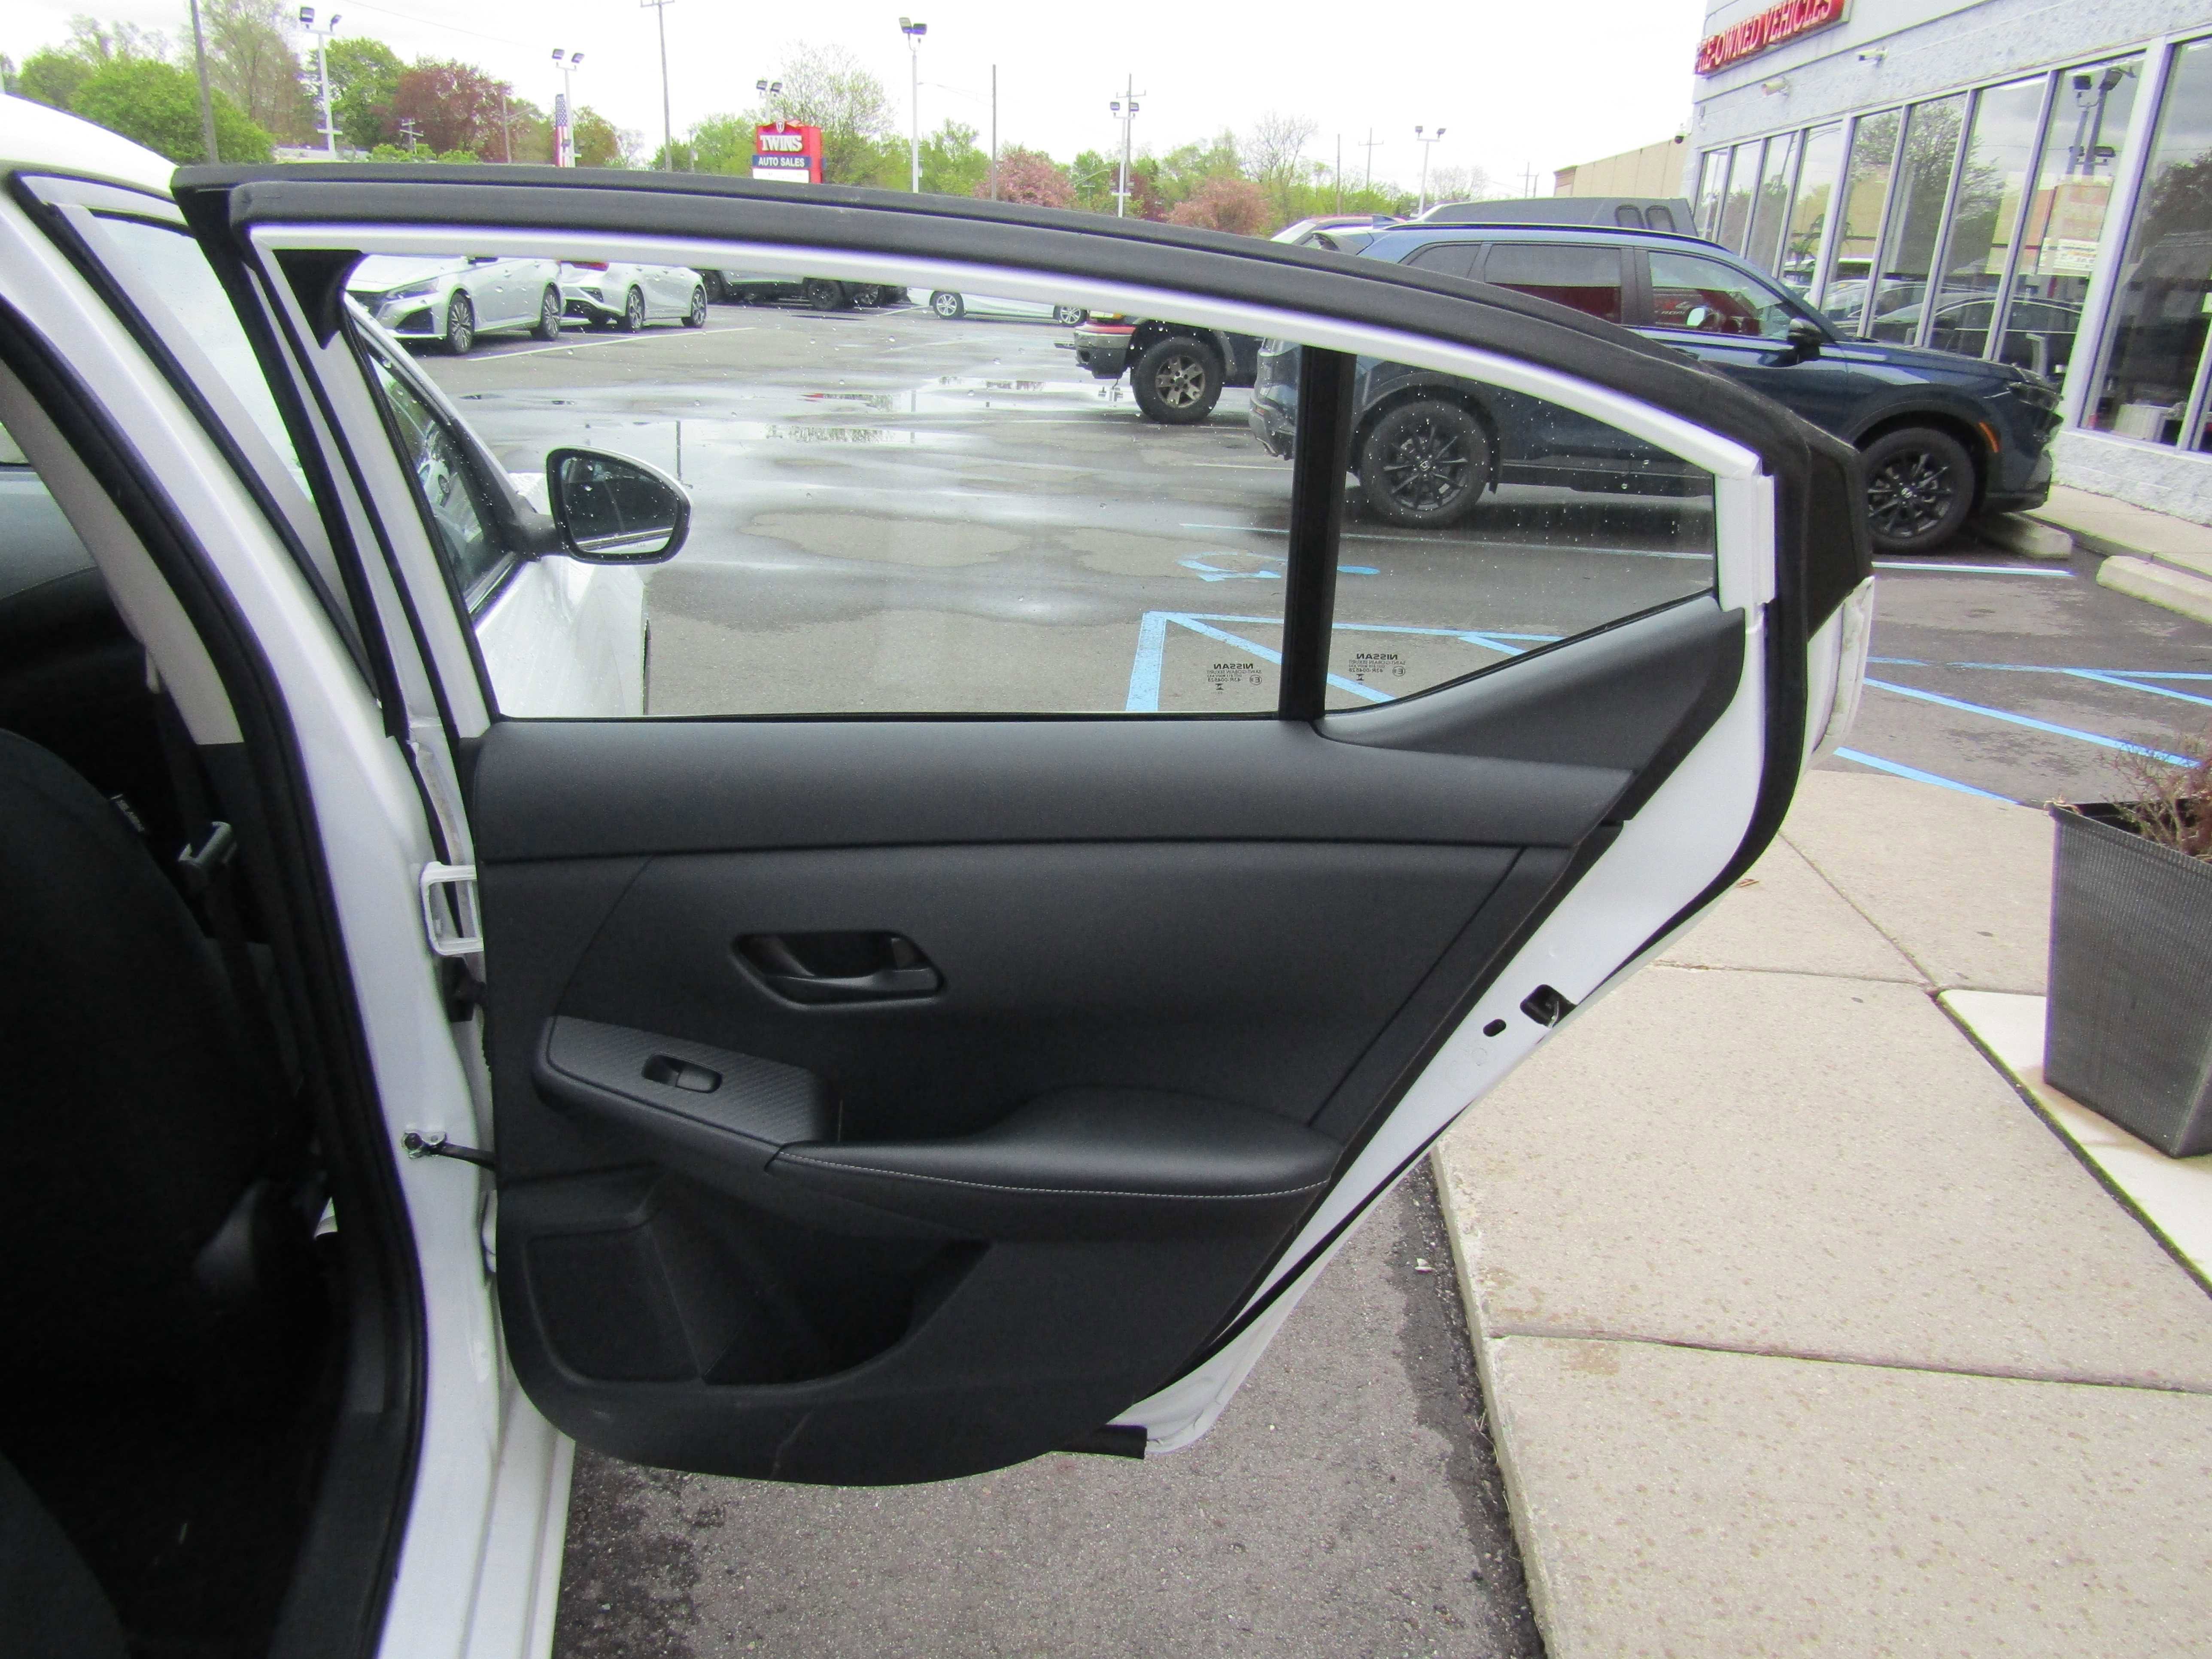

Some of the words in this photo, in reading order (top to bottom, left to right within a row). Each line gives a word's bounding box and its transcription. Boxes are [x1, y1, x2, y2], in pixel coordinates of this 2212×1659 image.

[1698, 15, 1761, 72] RE-OWNED
[1763, 0, 1831, 44] VEHICLES
[760, 135, 802, 152] TWINS
[758, 157, 778, 166] AUTO
[780, 157, 805, 167] SALES
